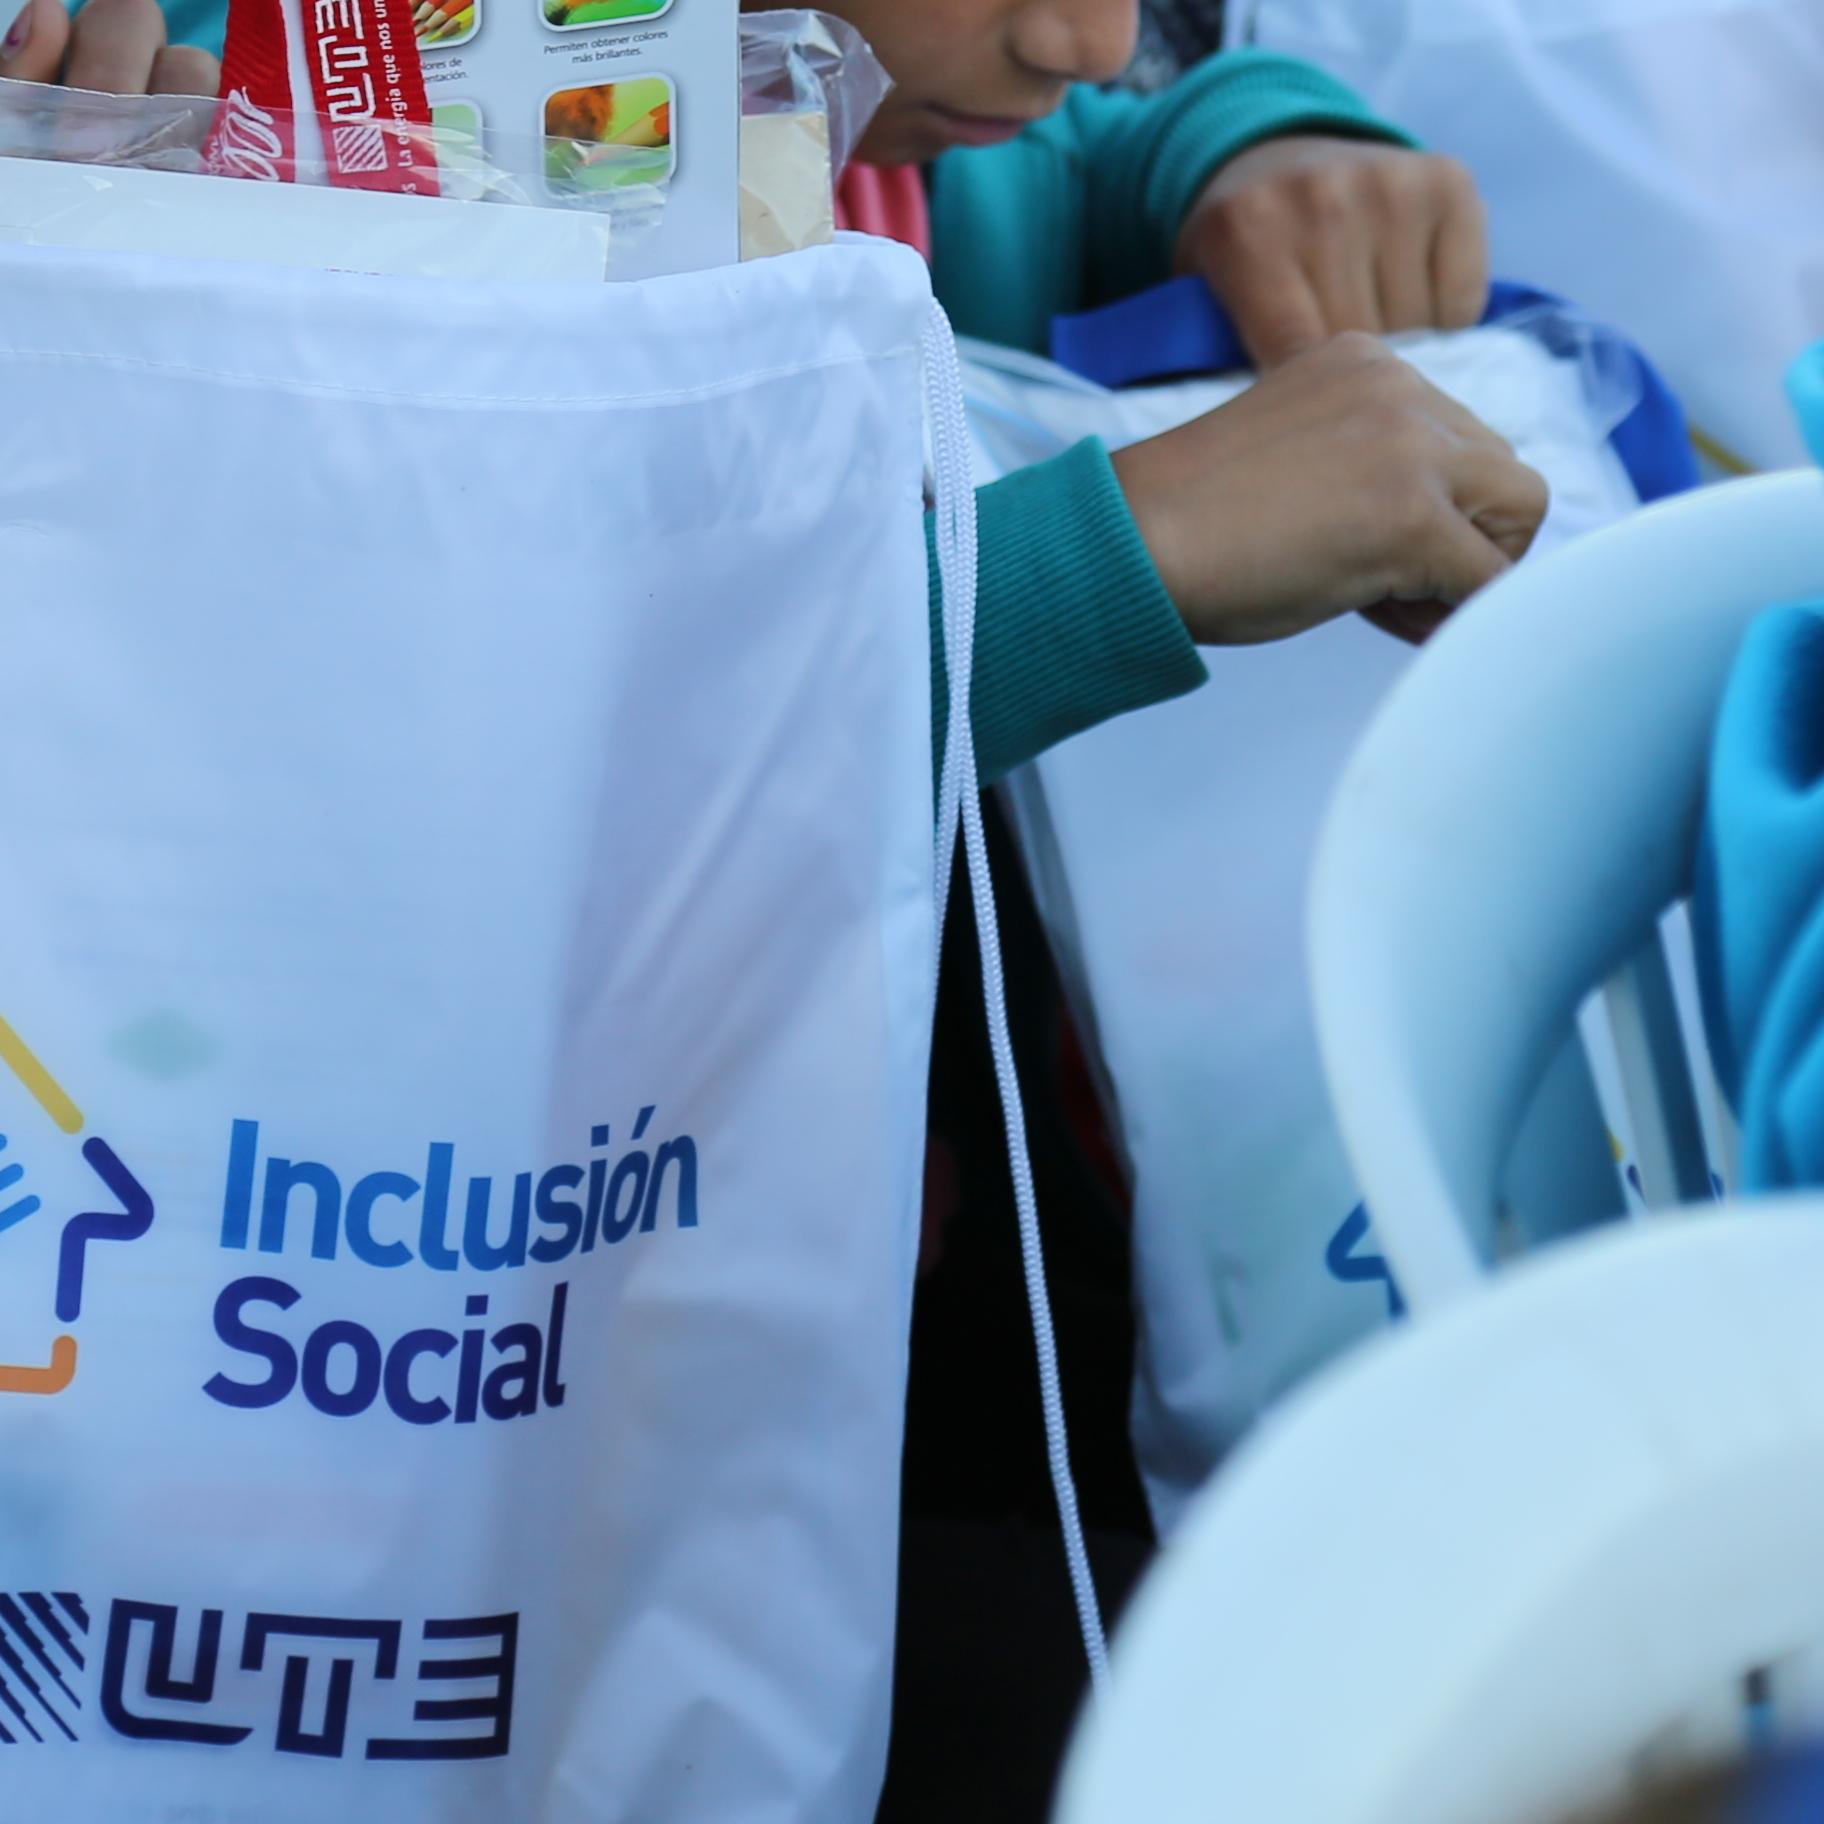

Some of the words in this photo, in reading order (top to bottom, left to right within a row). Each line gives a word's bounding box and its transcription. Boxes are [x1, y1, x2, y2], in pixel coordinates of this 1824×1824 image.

[377, 23, 394, 50] nos
[543, 41, 588, 55] Permiten
[591, 35, 630, 49] obtener
[632, 30, 668, 43] colores
[382, 55, 401, 84] que
[572, 52, 593, 64] más
[219, 1104, 699, 1273] Inclusión
[200, 1275, 570, 1426] Social
[99, 1597, 520, 1761] UTE
